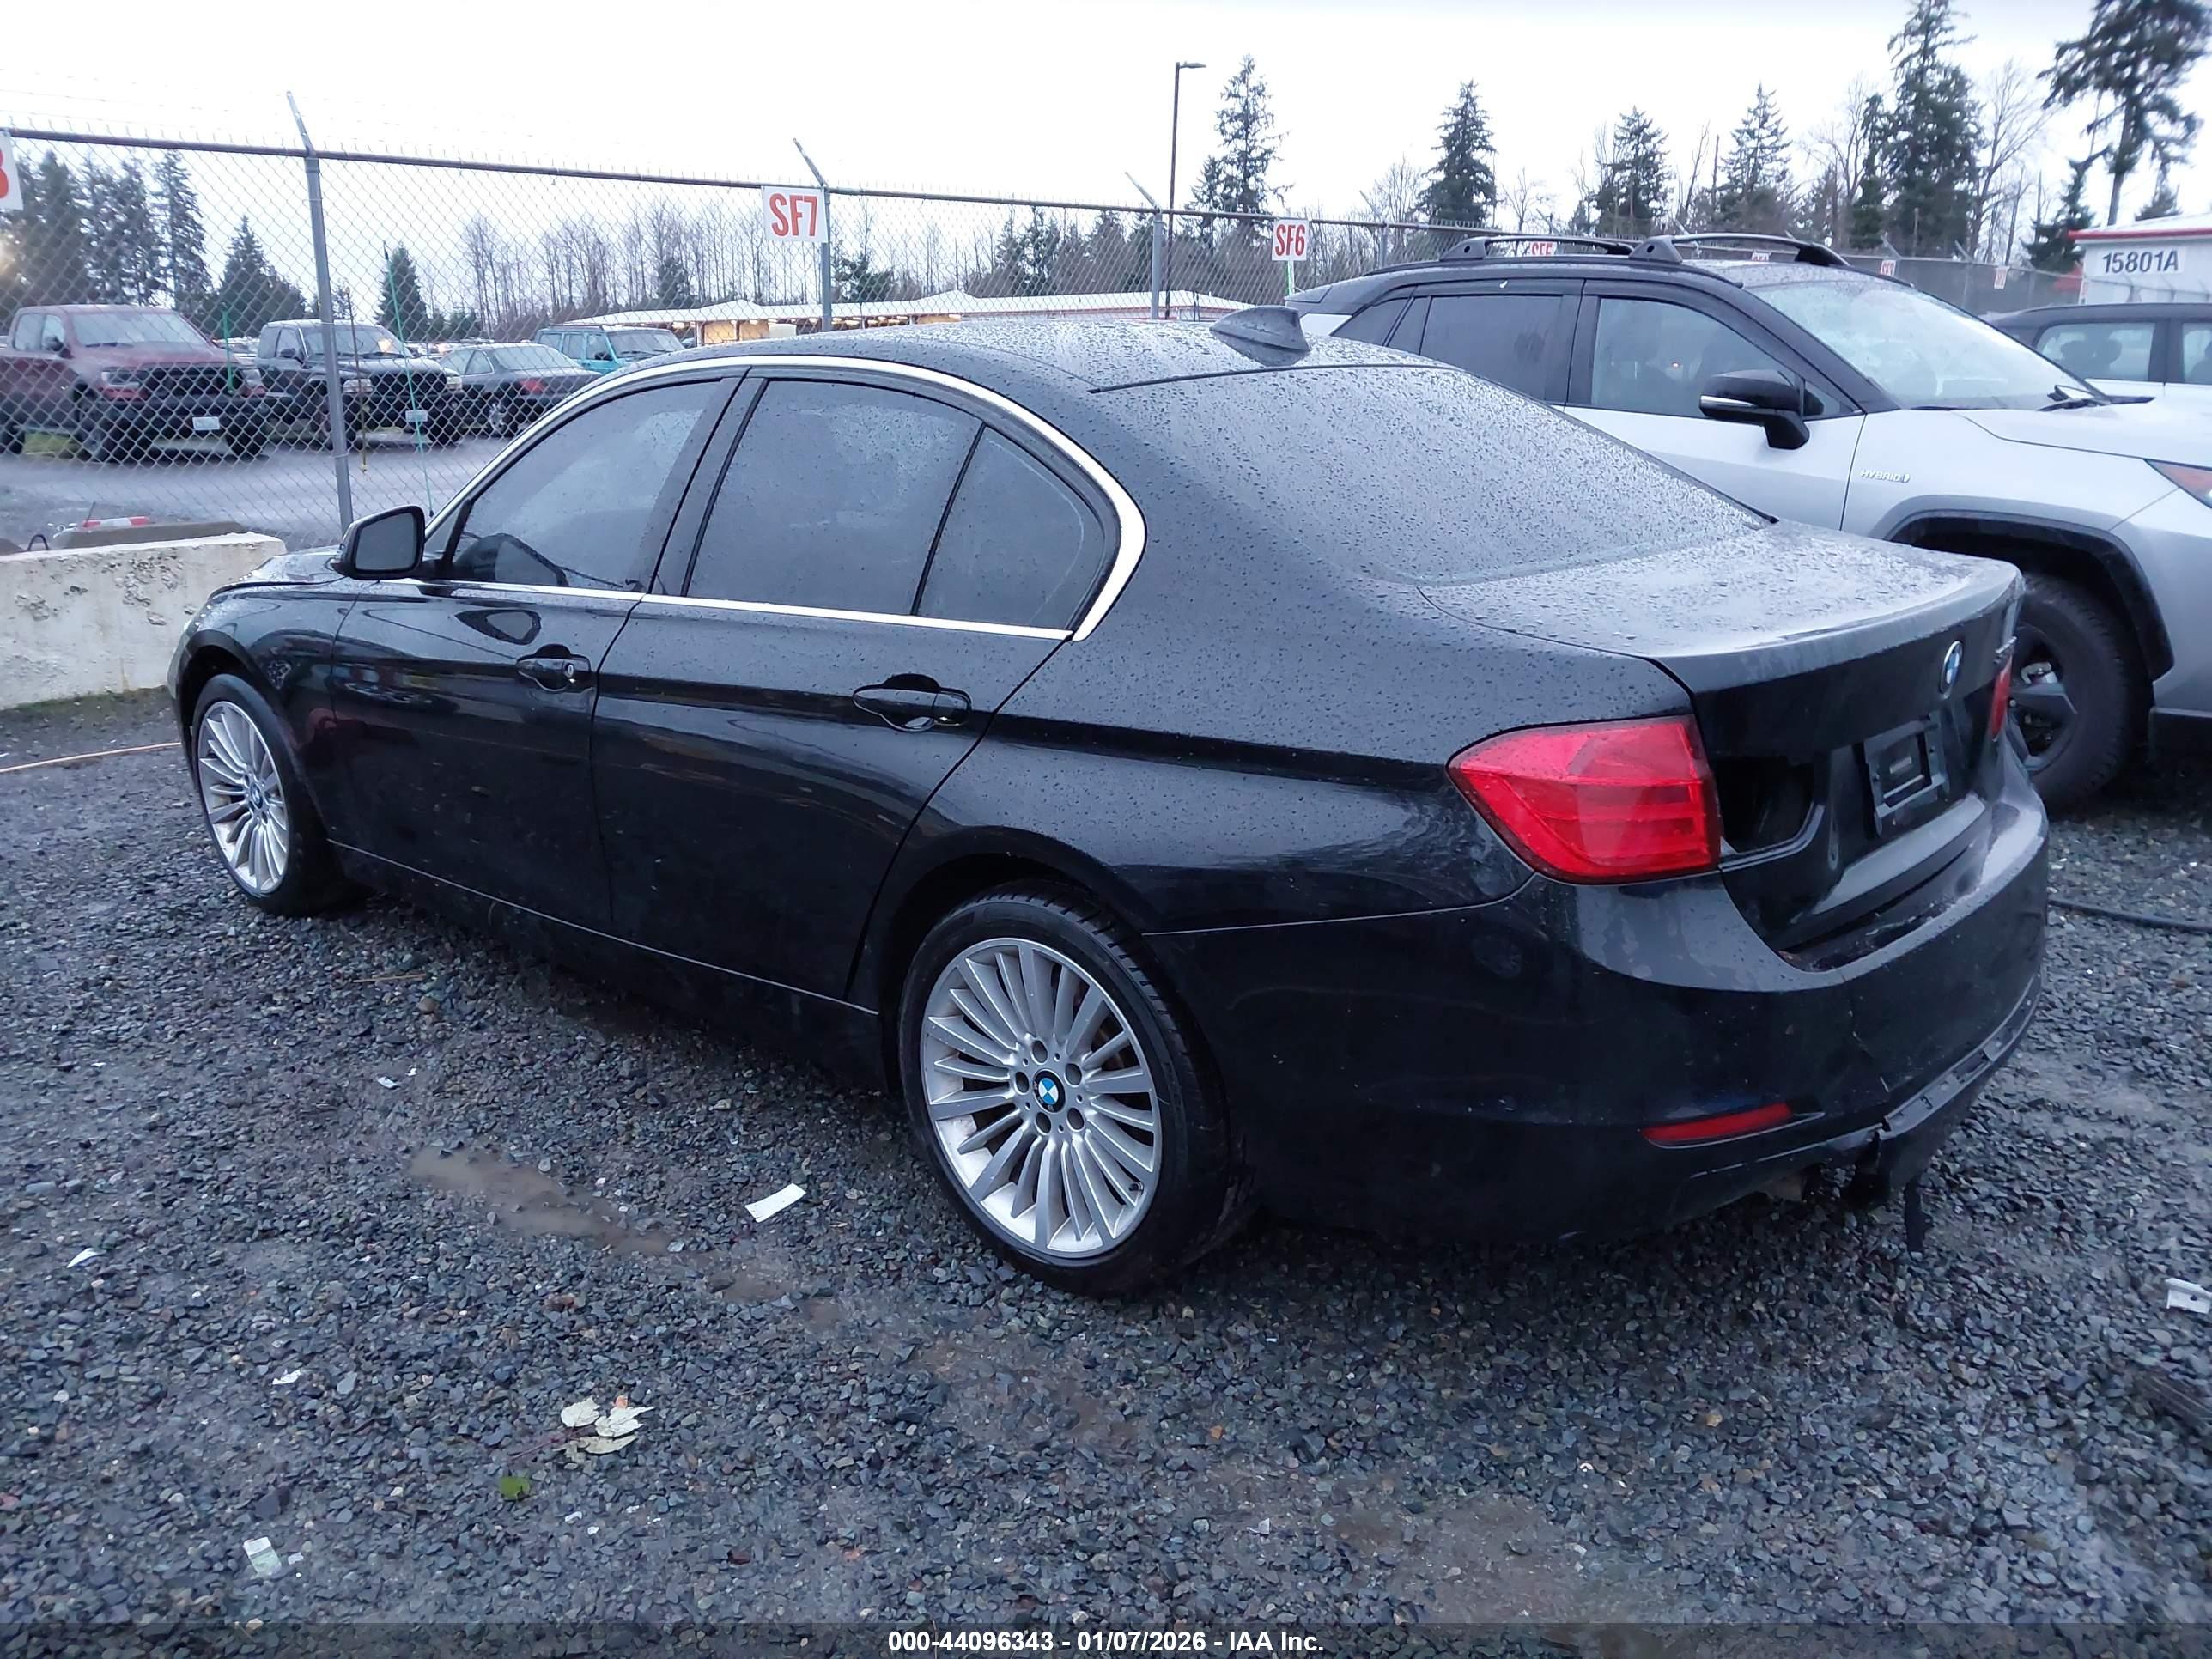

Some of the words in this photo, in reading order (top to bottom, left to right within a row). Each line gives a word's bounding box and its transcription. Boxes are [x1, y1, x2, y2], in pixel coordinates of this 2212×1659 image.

[769, 193, 817, 236] SF7
[1275, 224, 1305, 256] SF6
[2103, 250, 2179, 273] 15801A
[1861, 469, 1901, 482] HYBRID
